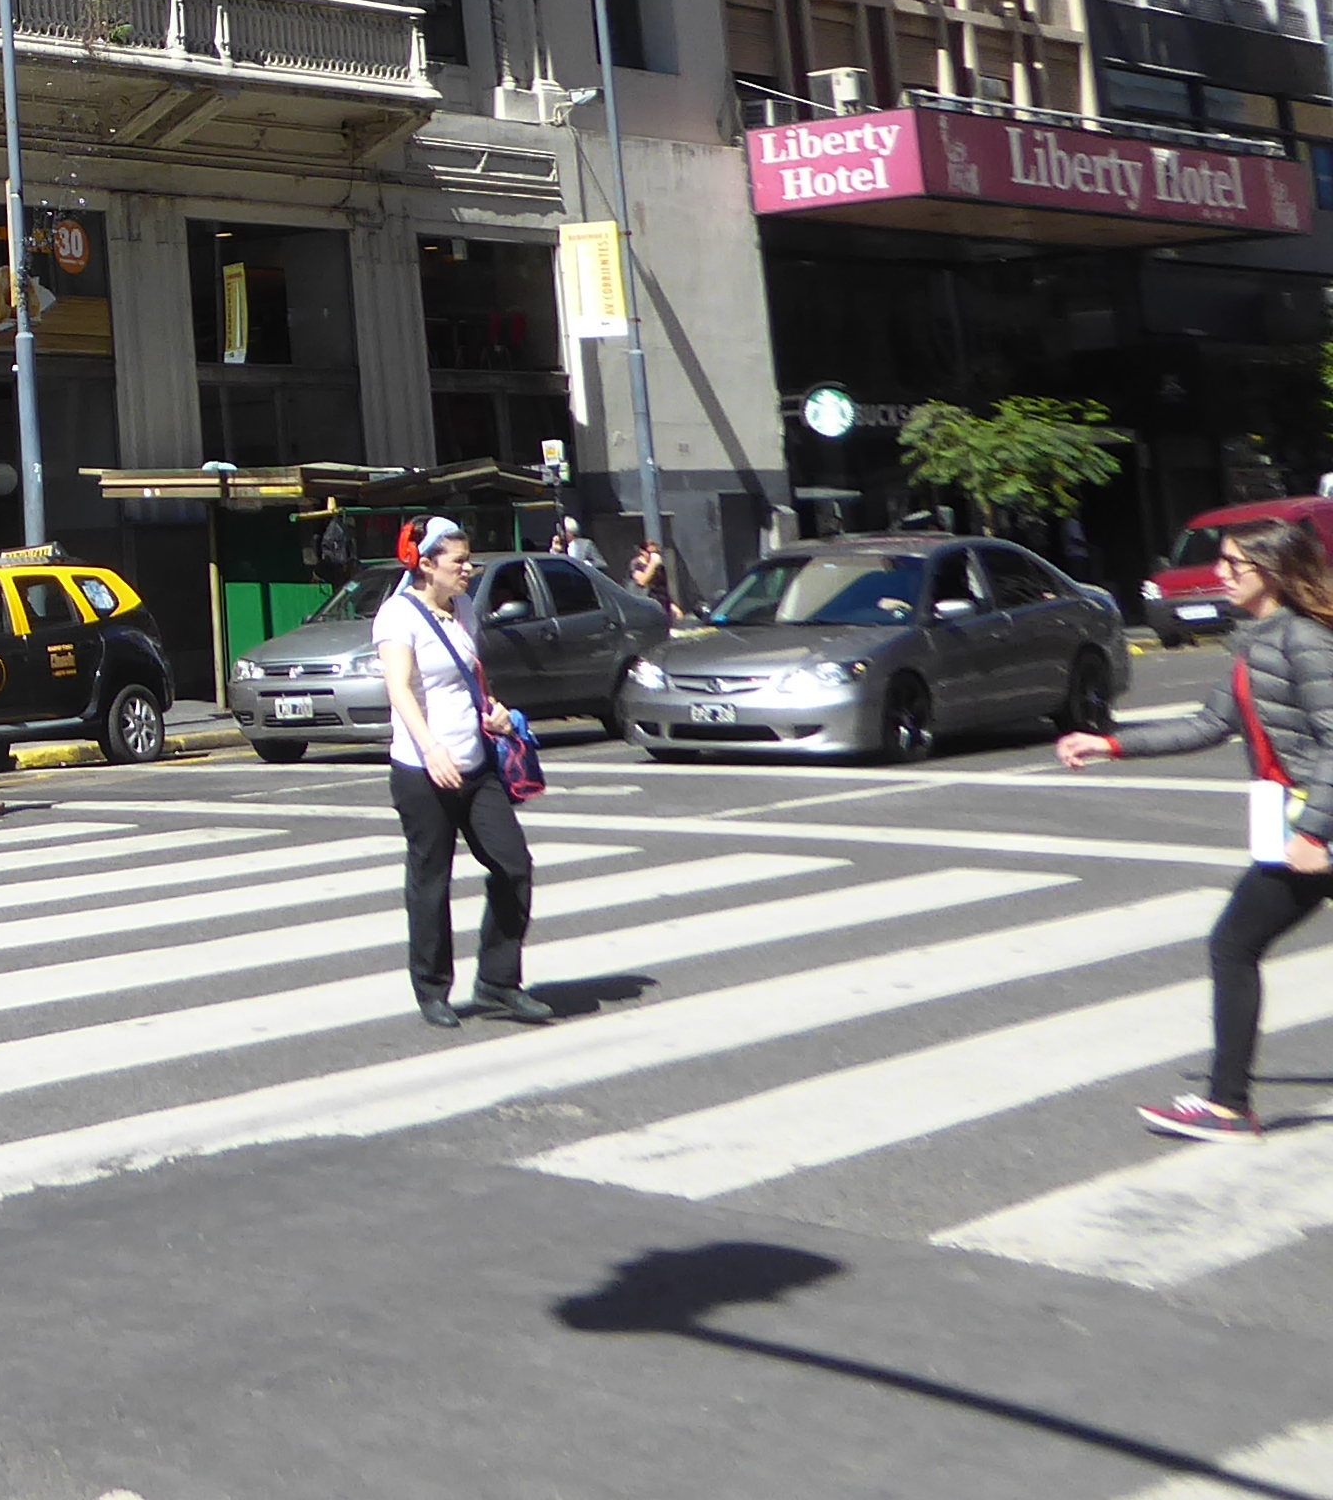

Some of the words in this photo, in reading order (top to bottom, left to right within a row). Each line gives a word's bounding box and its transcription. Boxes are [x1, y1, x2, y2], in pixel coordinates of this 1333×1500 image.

[758, 122, 902, 164] Liberty
[1004, 126, 1143, 211] Liberty
[1150, 146, 1247, 210] Hotel
[779, 157, 890, 200] Hotel
[597, 240, 614, 301] CORRIENTES
